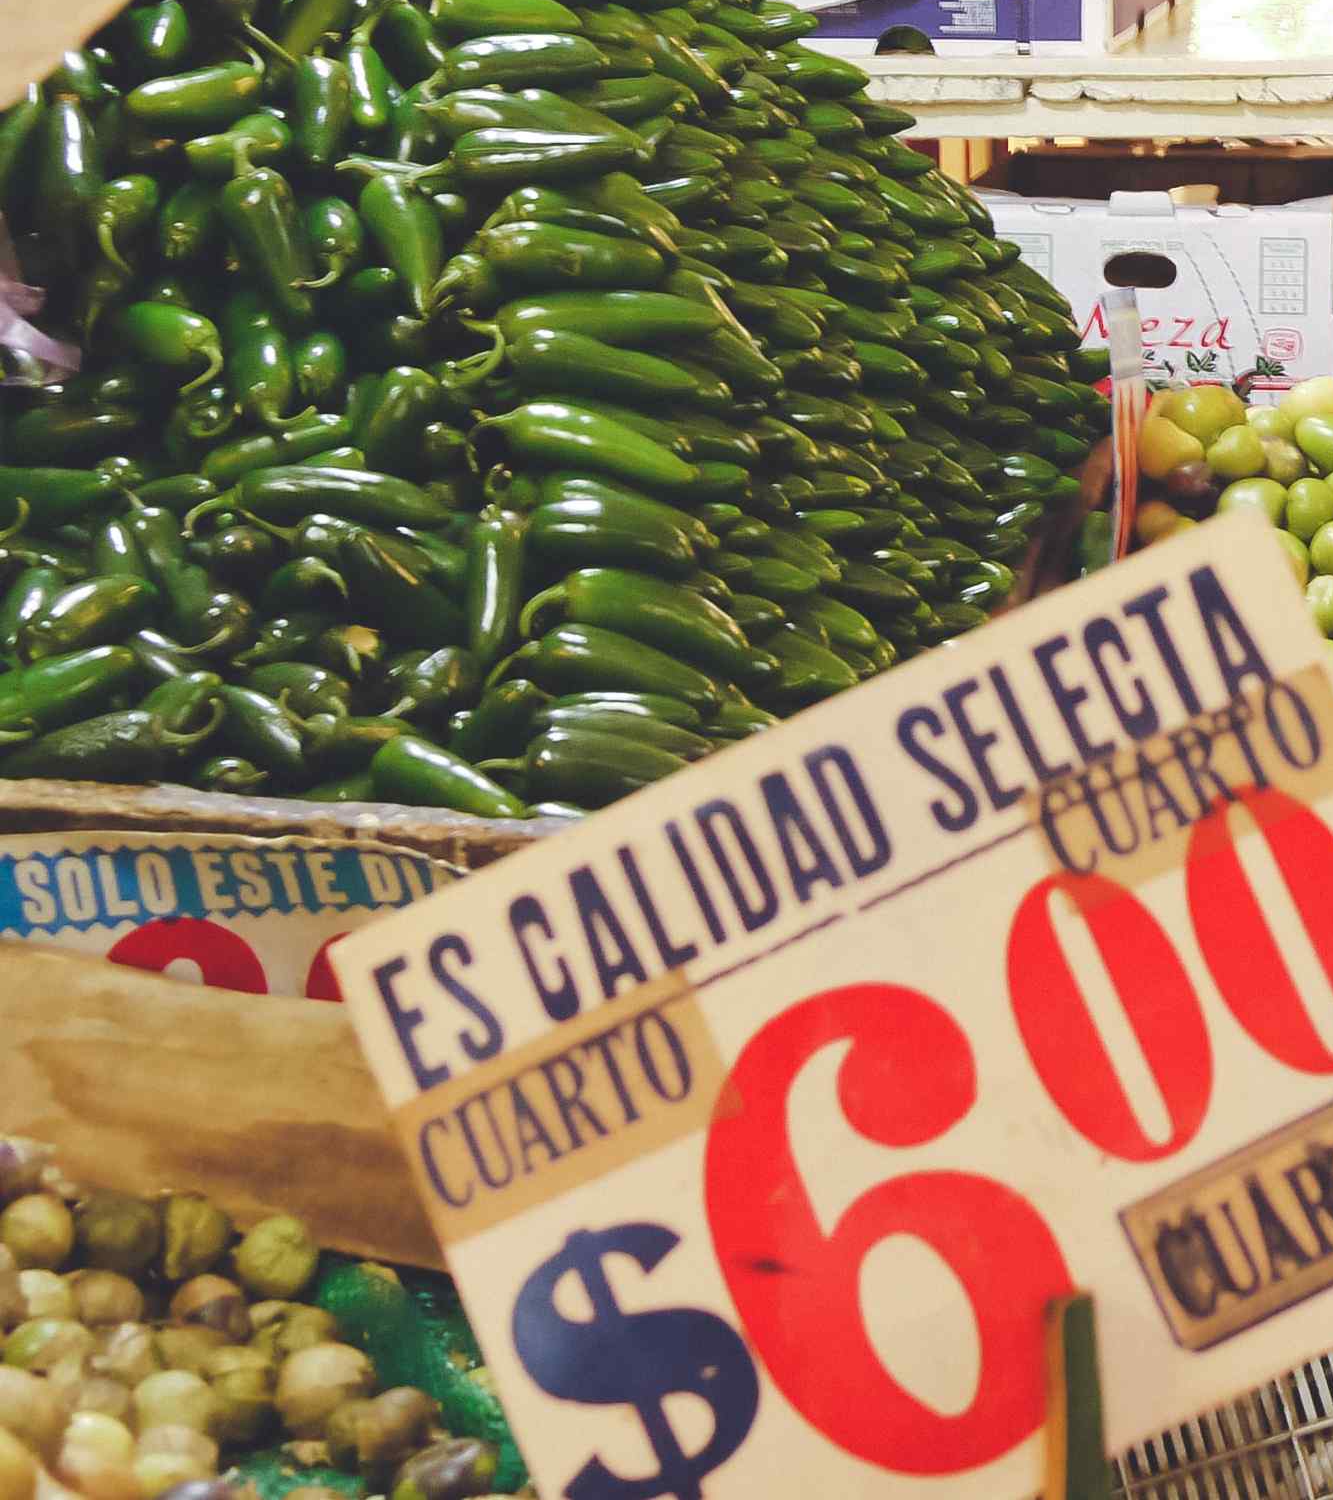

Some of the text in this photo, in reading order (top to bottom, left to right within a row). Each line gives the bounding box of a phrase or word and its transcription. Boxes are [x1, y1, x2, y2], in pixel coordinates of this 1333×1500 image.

[372, 563, 1286, 1091] ES CALIDAD SELECTA
[1037, 678, 1325, 881] CUARTO
[13, 850, 432, 925] SOLO ESTE DI
[414, 1000, 697, 1212] CUARTO
